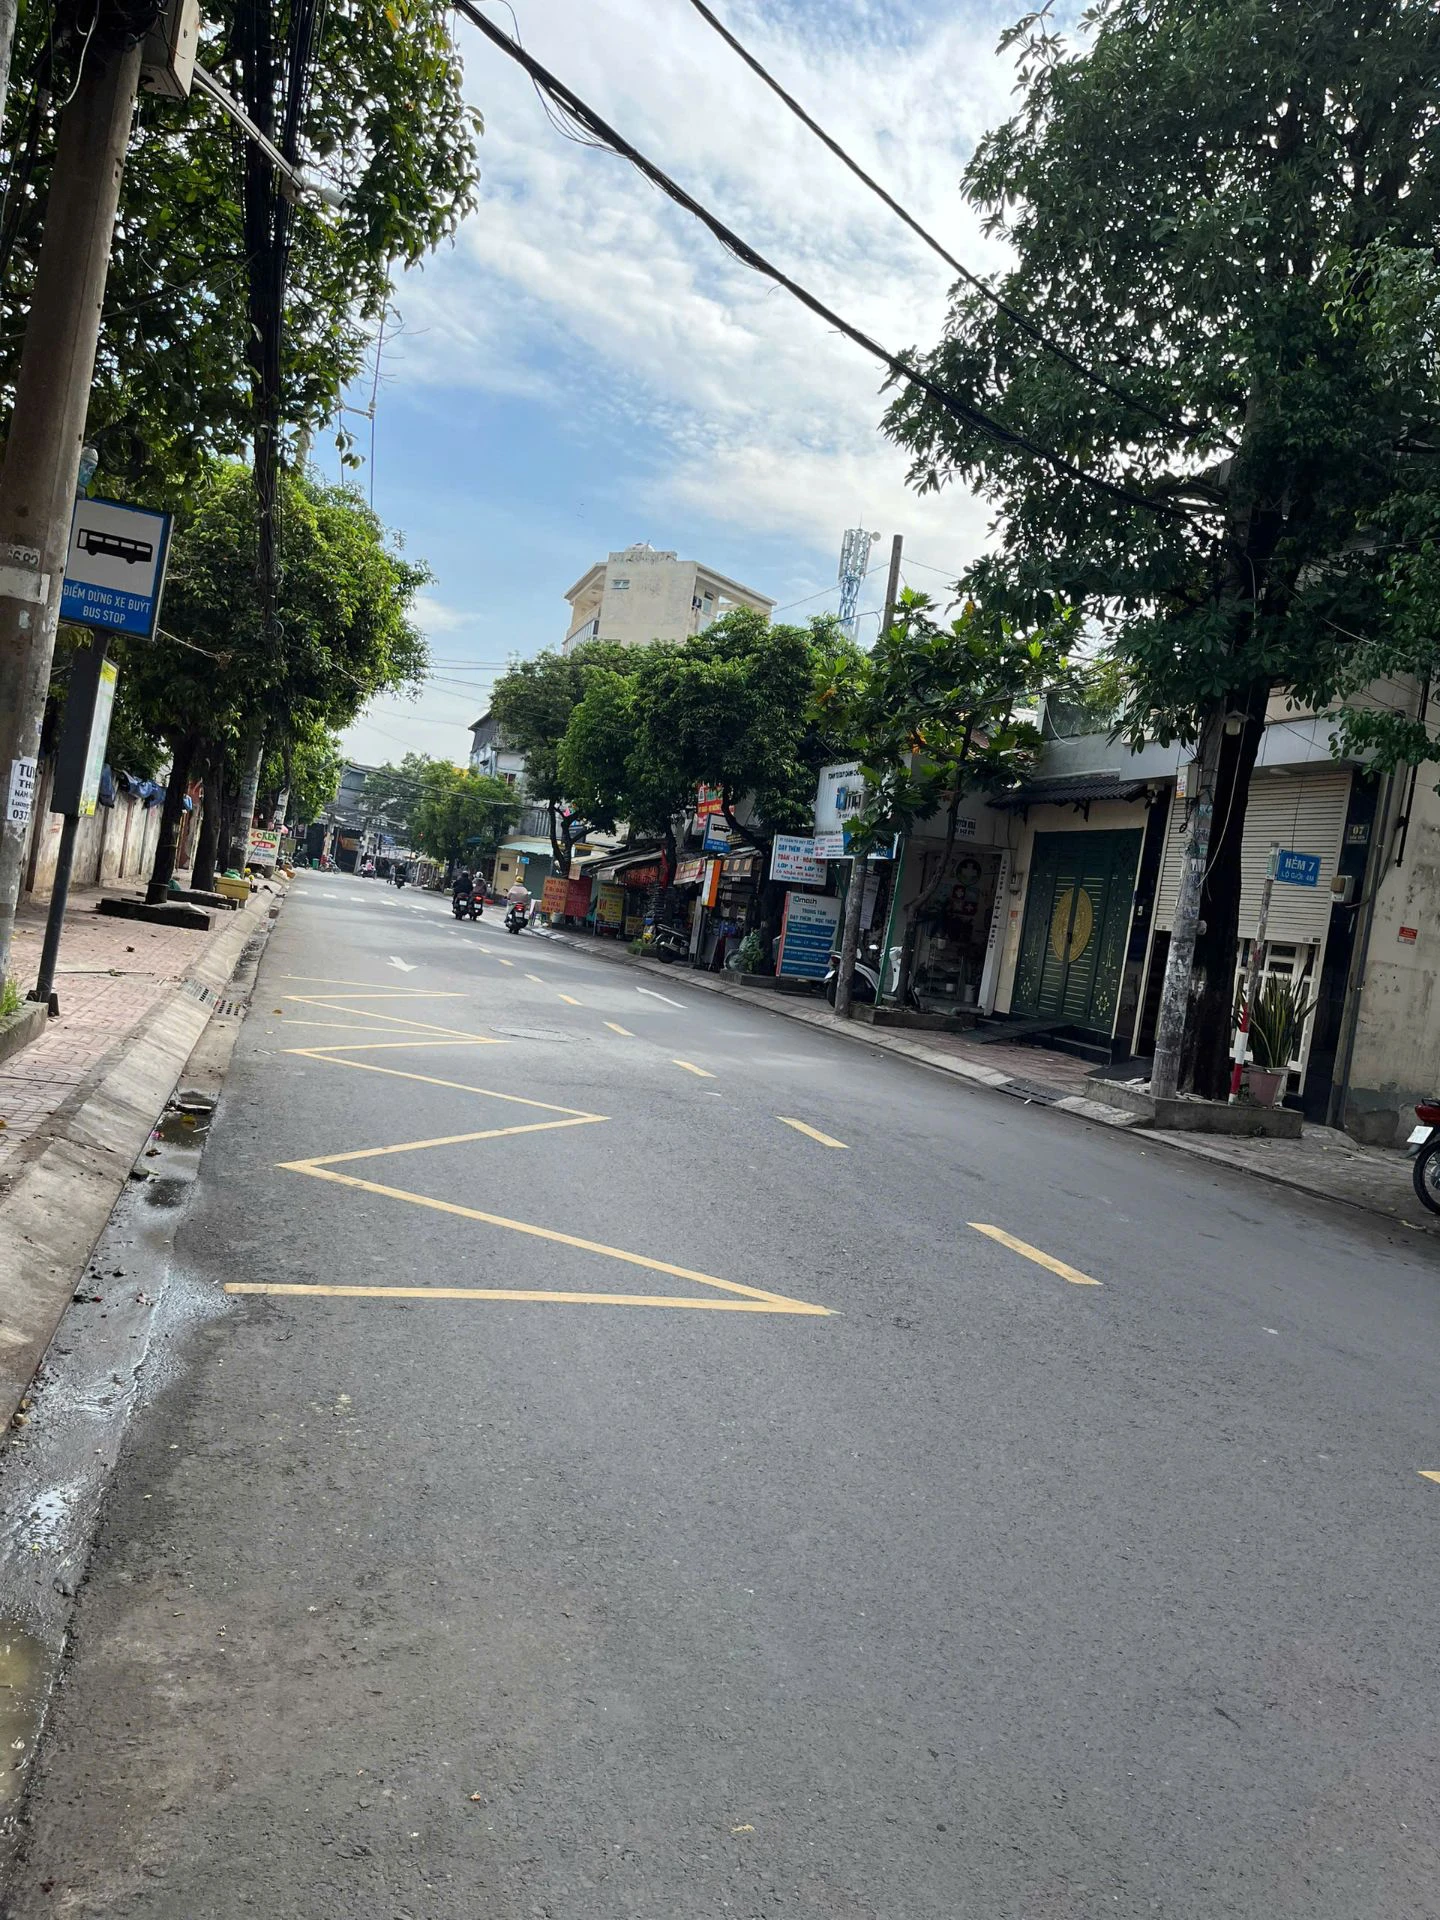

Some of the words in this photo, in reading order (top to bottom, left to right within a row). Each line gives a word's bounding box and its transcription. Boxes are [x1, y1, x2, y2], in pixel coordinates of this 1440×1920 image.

[63, 583, 86, 599] ĐIỂM
[87, 590, 113, 605] DỪNG
[114, 596, 126, 608] XE
[127, 599, 151, 614] BUÝT
[83, 605, 101, 619] BUS
[102, 610, 126, 624] STOP
[1353, 825, 1364, 835] 07
[1285, 855, 1306, 871] HẺM
[1308, 861, 1315, 872] 7
